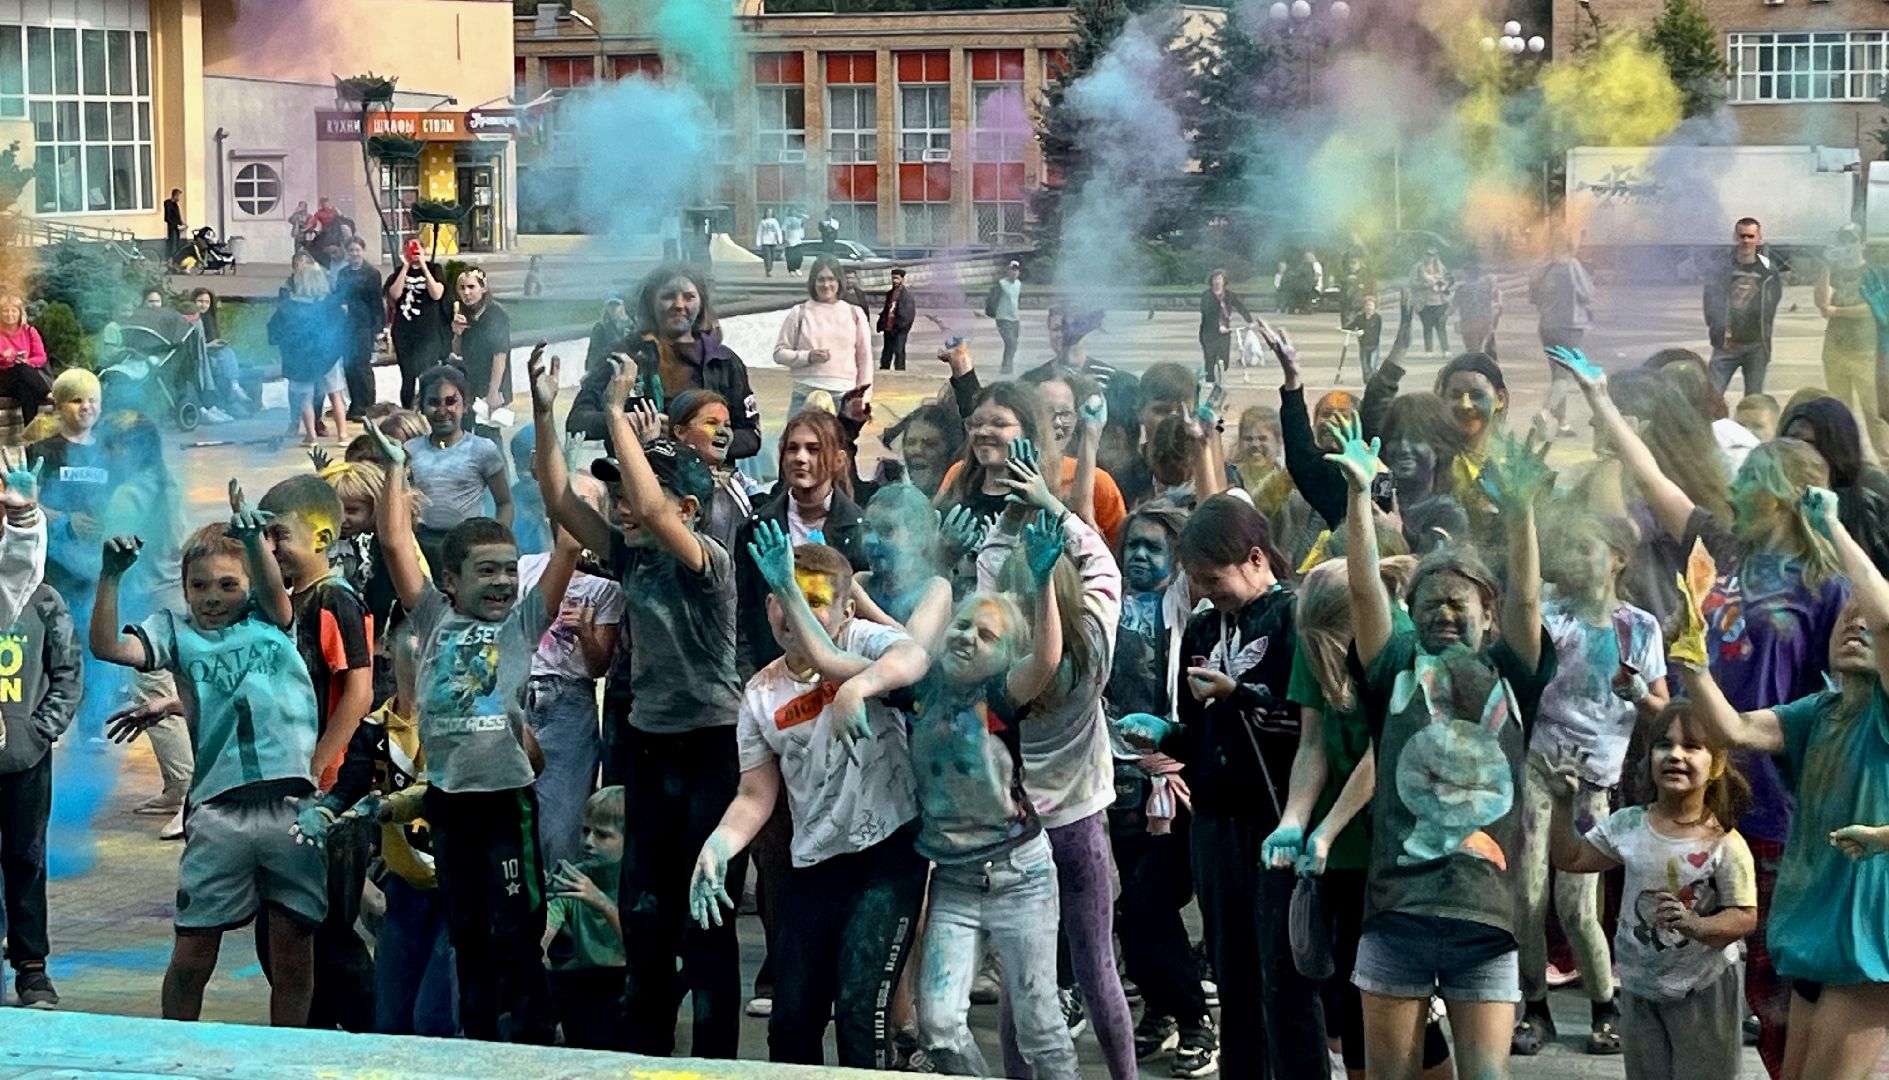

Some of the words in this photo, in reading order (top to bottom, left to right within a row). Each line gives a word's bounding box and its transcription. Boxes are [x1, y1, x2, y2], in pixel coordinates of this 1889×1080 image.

[327, 119, 360, 133] КУХНИ
[374, 119, 415, 133] ШКАФЫ
[422, 119, 455, 132] СТОЛЫ
[188, 640, 281, 683] QATAR
[502, 858, 518, 879] 10
